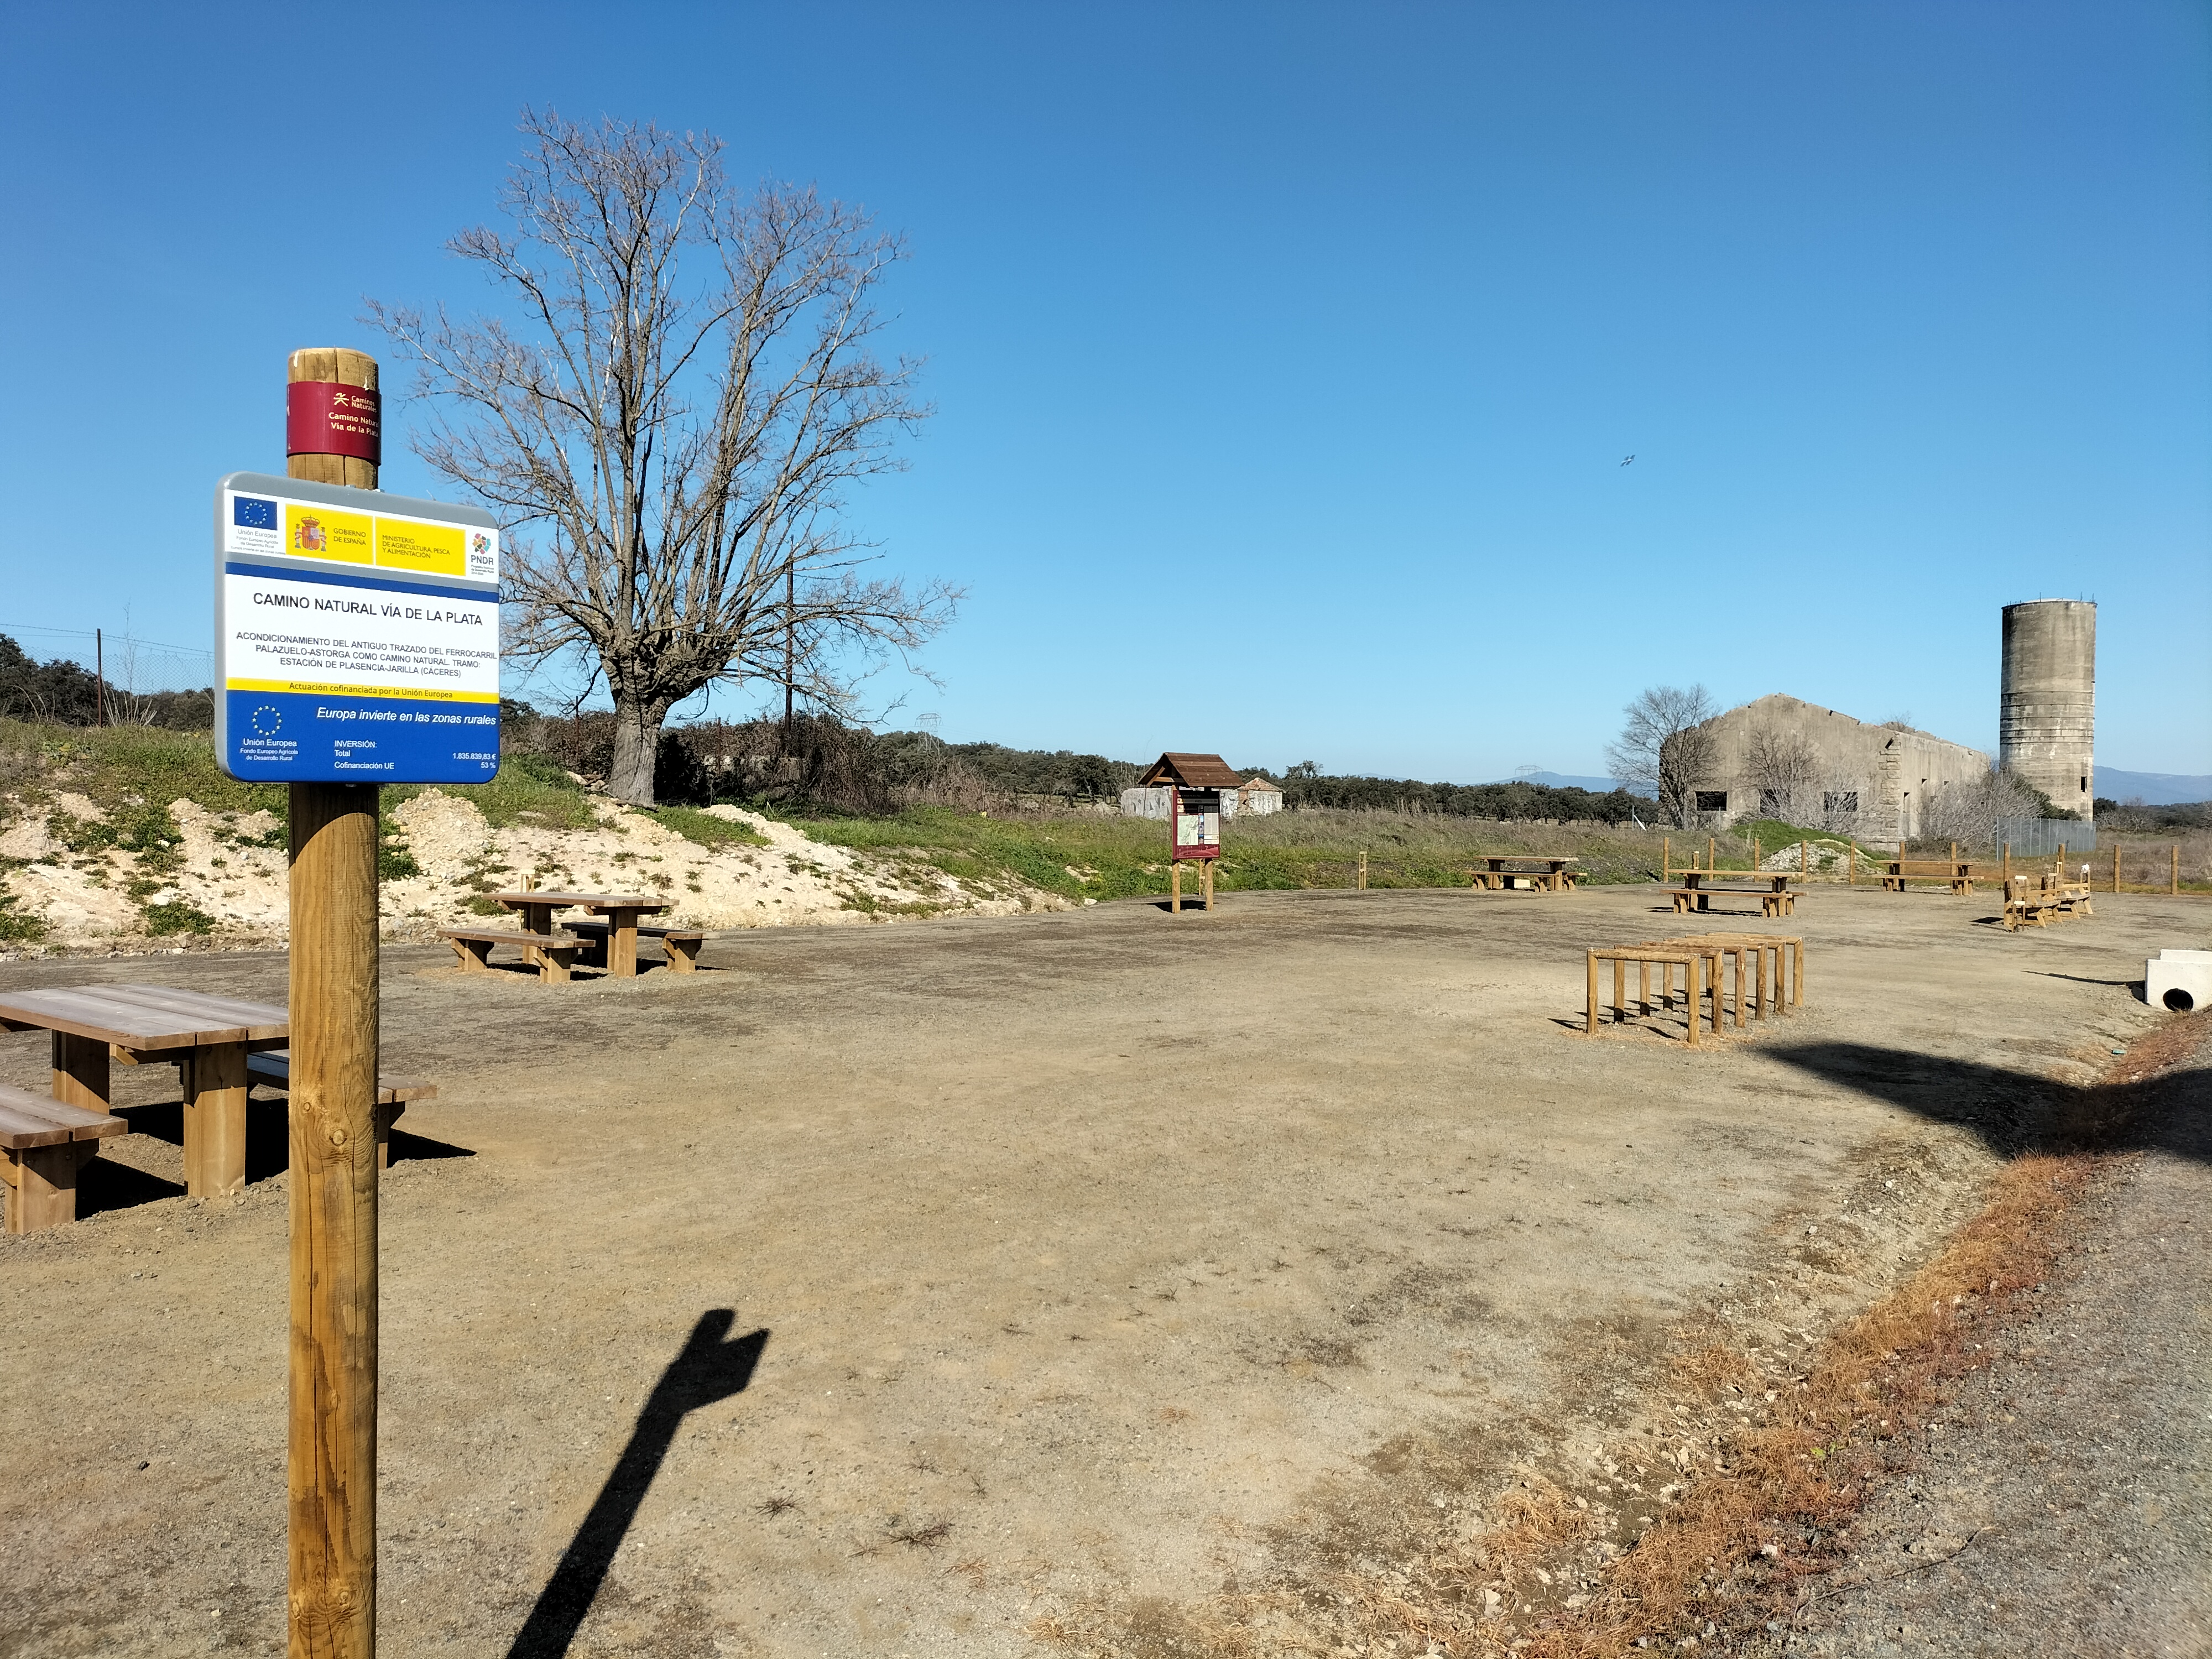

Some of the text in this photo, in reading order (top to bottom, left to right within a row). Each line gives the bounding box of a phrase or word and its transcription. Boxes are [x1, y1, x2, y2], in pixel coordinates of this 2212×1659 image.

[351, 395, 375, 406] Caminos
[351, 401, 377, 413] Naturales
[328, 412, 359, 422] Camino
[366, 427, 379, 437] Plata
[333, 528, 367, 538] GOBIERNO
[343, 537, 367, 546] ESPAÑA
[382, 534, 415, 544] MINISTERIO
[387, 548, 431, 559] ALIMENTACIÓN
[471, 555, 494, 565] PNDR
[253, 592, 483, 626] CAMINO NATURAL VÍA DE LA PLATA
[236, 632, 497, 660] ACONDICIONAMIENTO DEL ANTIGUO TRAZADO DEL FERROCARRIL
[255, 644, 351, 659] PALAZUELO-ASTORGA
[352, 651, 378, 660] COMO
[380, 654, 411, 663] CAMINO
[452, 659, 481, 668] TRAMO:
[280, 657, 461, 679] ESTACIÓN DE PLASENCIA-JARILLA (CÁCERES)
[289, 682, 328, 691] Actuación
[330, 685, 377, 694] cofinanciada
[425, 690, 453, 699] Europea
[317, 707, 497, 725] Europa invierte en las zonas rurales
[243, 738, 298, 748] Unión Europea
[334, 740, 378, 748] INVERSIÓN:
[334, 761, 383, 769] Cofinanciación
